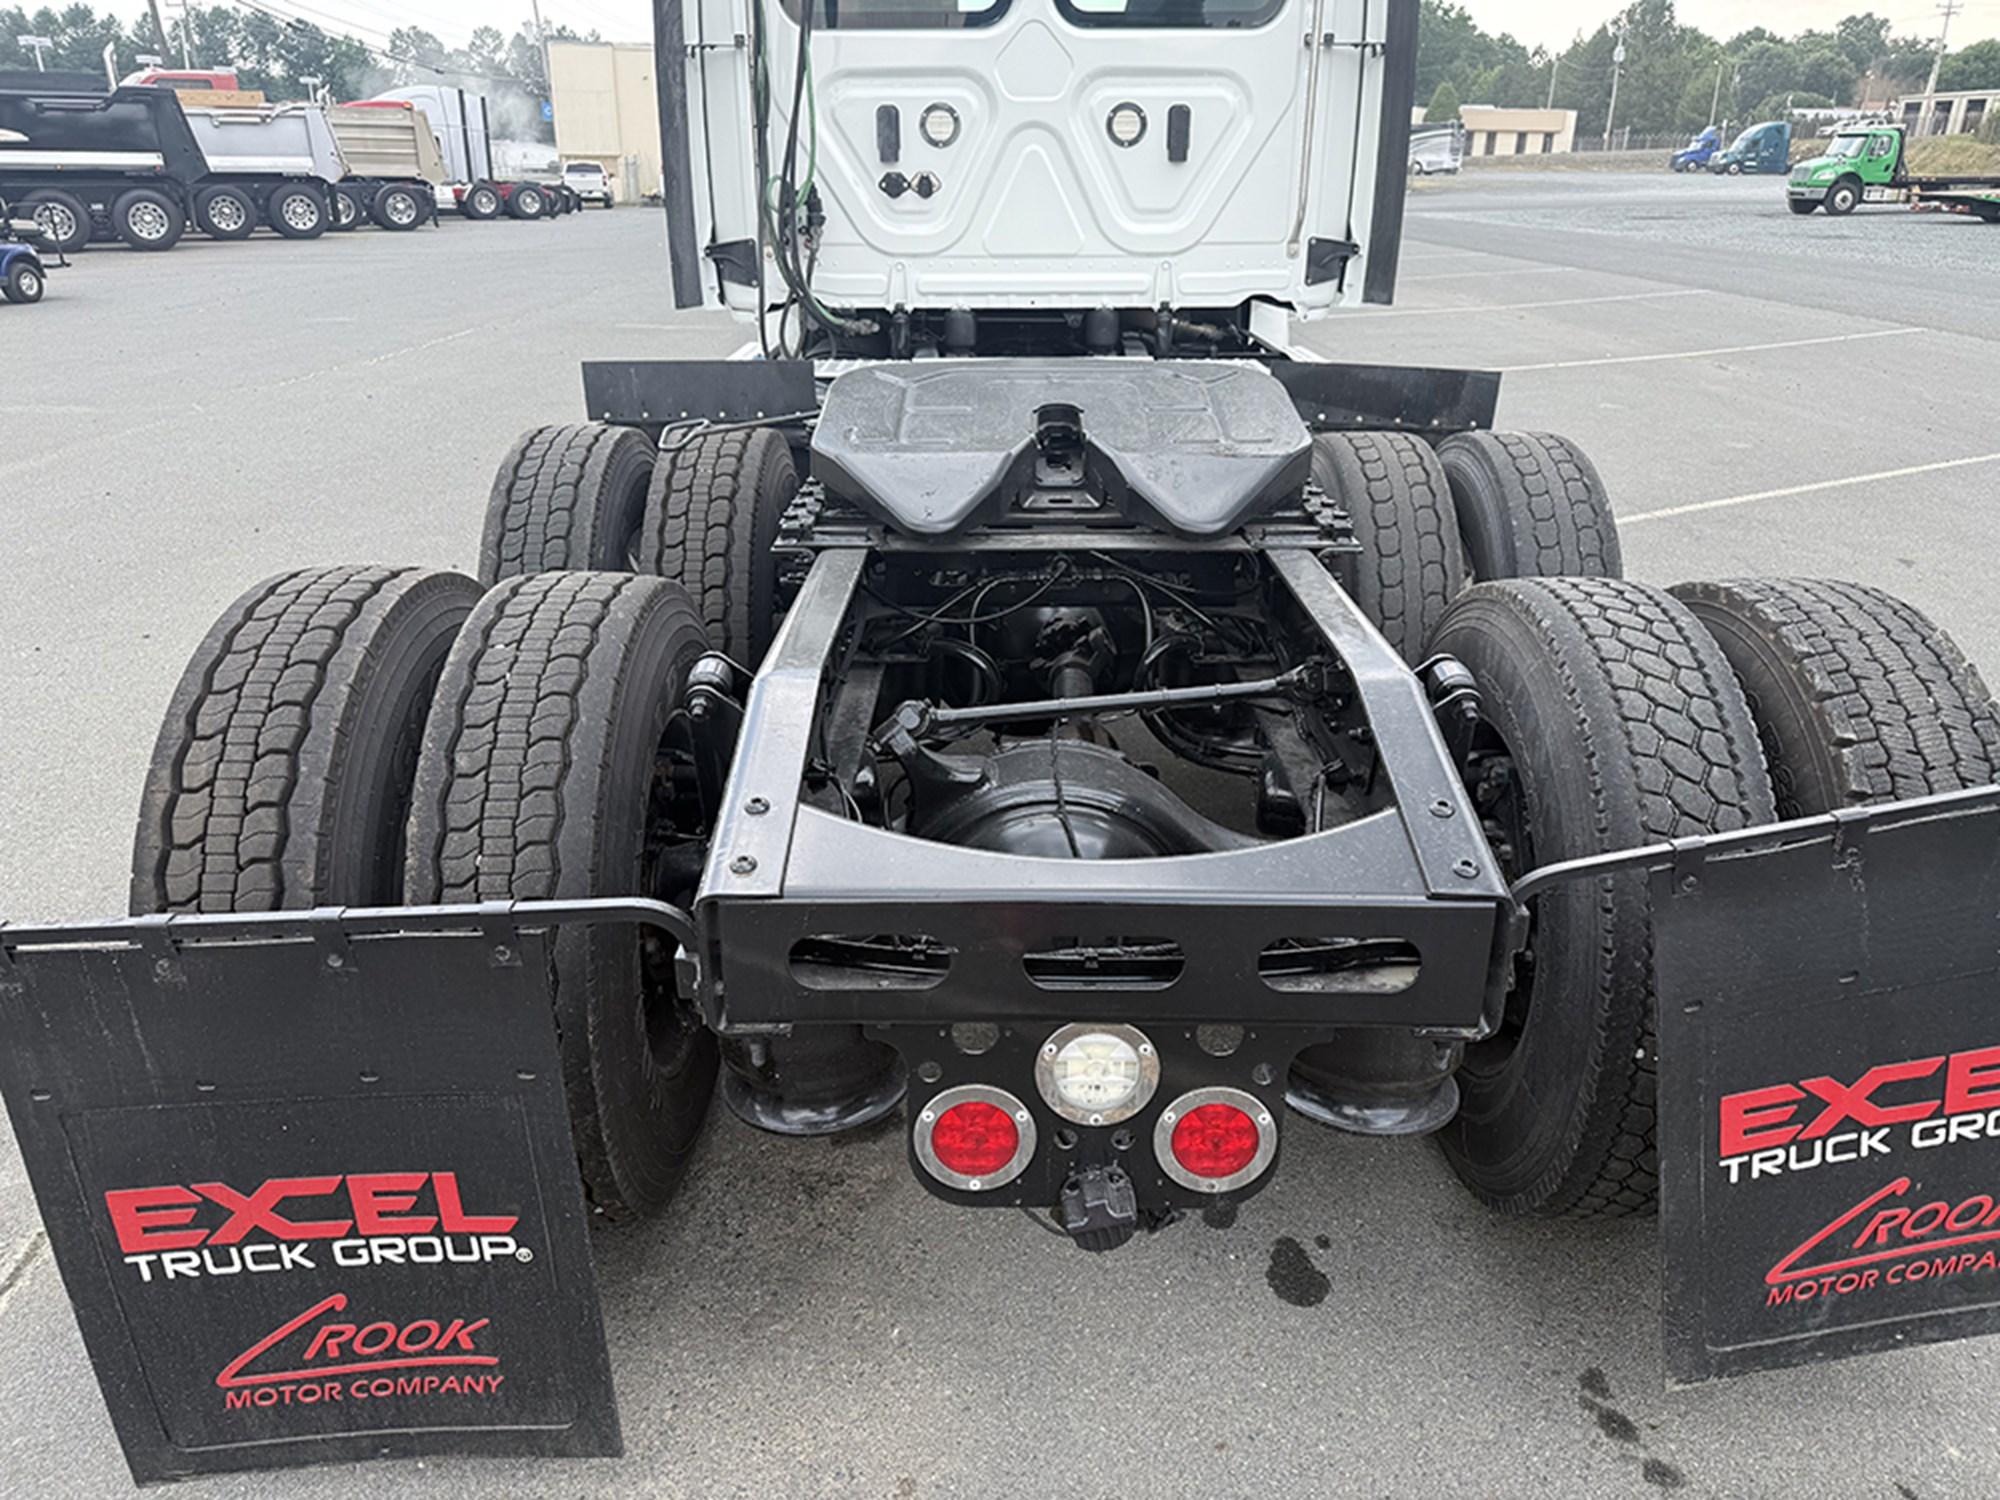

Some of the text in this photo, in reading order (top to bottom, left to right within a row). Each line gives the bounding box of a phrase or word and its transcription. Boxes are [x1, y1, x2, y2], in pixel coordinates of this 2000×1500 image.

[1719, 1127, 1891, 1183] TRUCK
[105, 1171, 518, 1254] EXCEL
[124, 1242, 316, 1282] TRUCK
[1766, 1251, 2000, 1306] MOTOR COMPA
[216, 1294, 499, 1389] CROOK
[225, 1375, 504, 1409] MOTOR COMPANY
